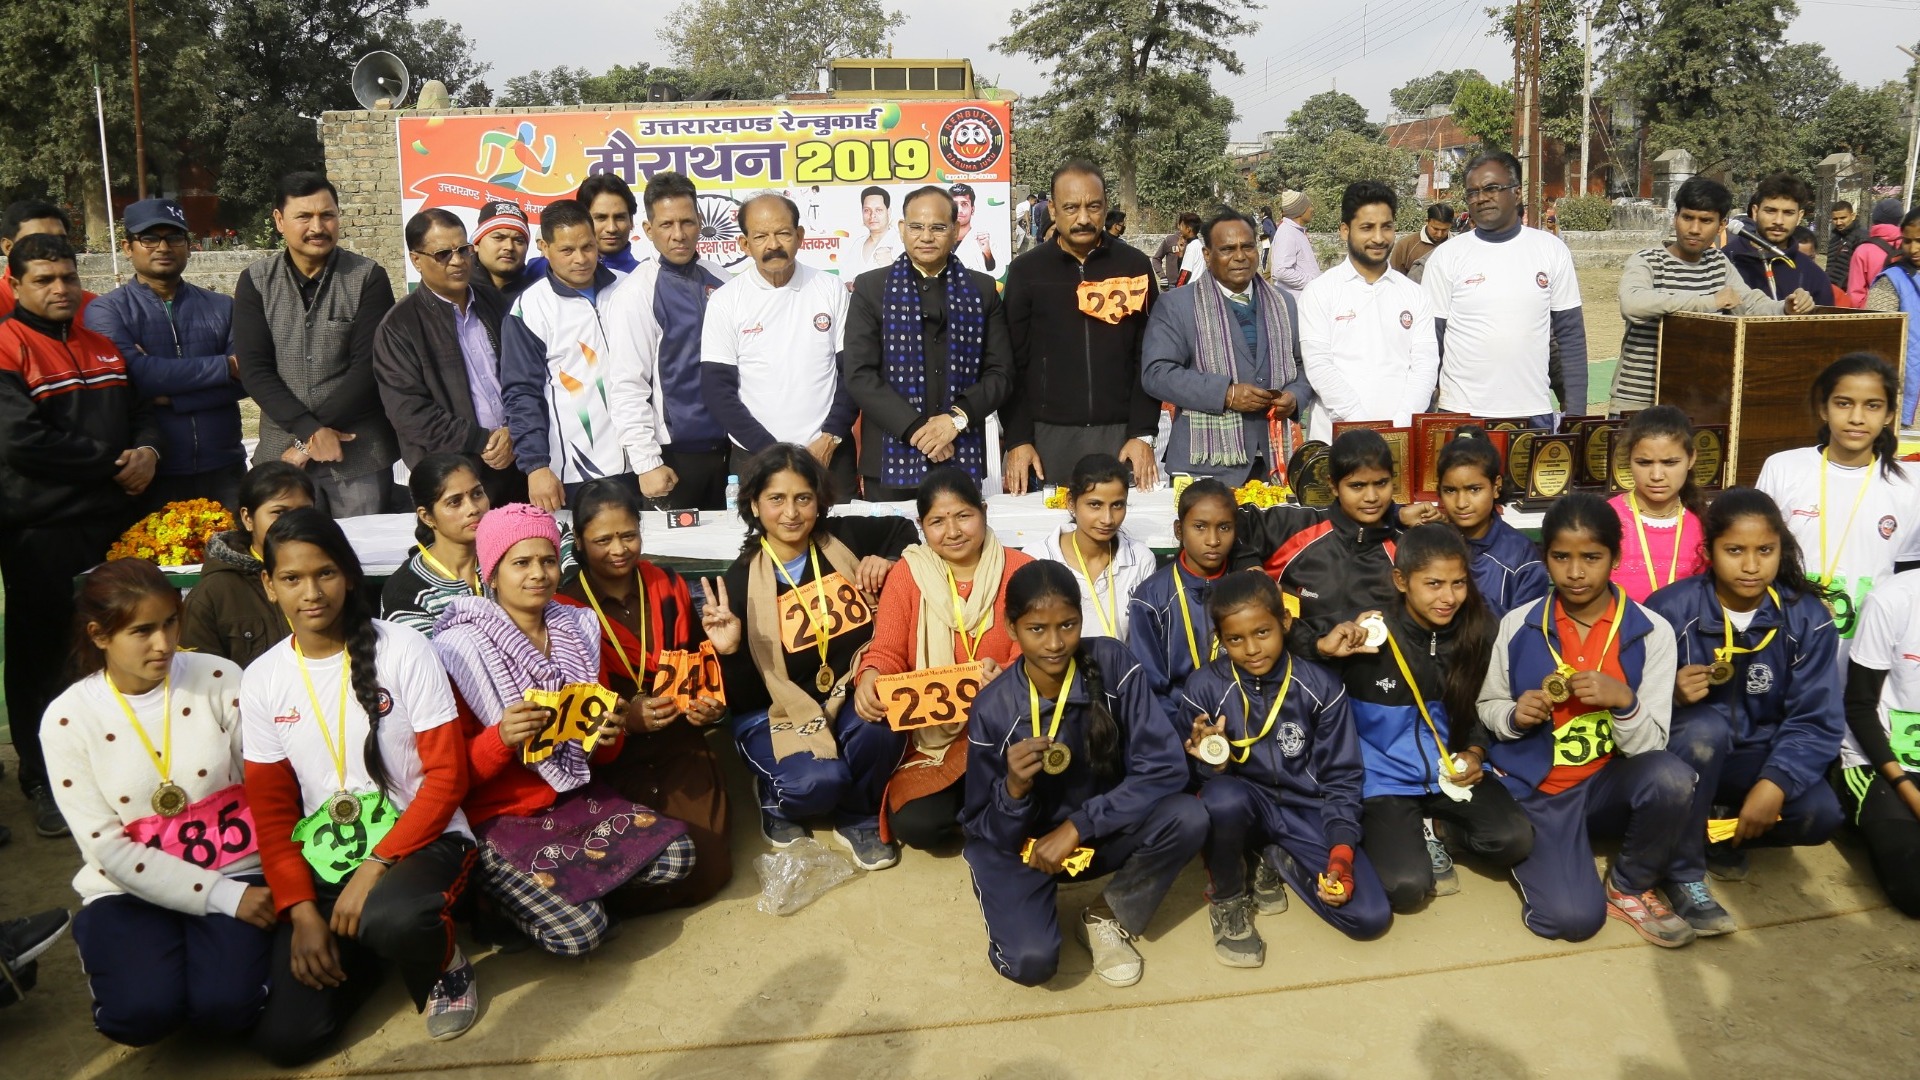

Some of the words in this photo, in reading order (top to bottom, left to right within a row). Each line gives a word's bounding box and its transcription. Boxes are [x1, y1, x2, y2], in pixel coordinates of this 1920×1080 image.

[640, 116, 773, 136] उत्तराखण्ड
[777, 107, 884, 136] रेन्बुकाई
[945, 110, 997, 131] RENBUKAI
[586, 129, 788, 185] मैराथन
[796, 138, 931, 182] 2019
[946, 152, 978, 170] DARUMA
[437, 182, 480, 200] उत्तराखण्ड
[785, 584, 867, 649] 238
[652, 653, 721, 700] 240
[528, 693, 609, 753] 219
[891, 678, 980, 727] 239
[1560, 719, 1615, 763] 58
